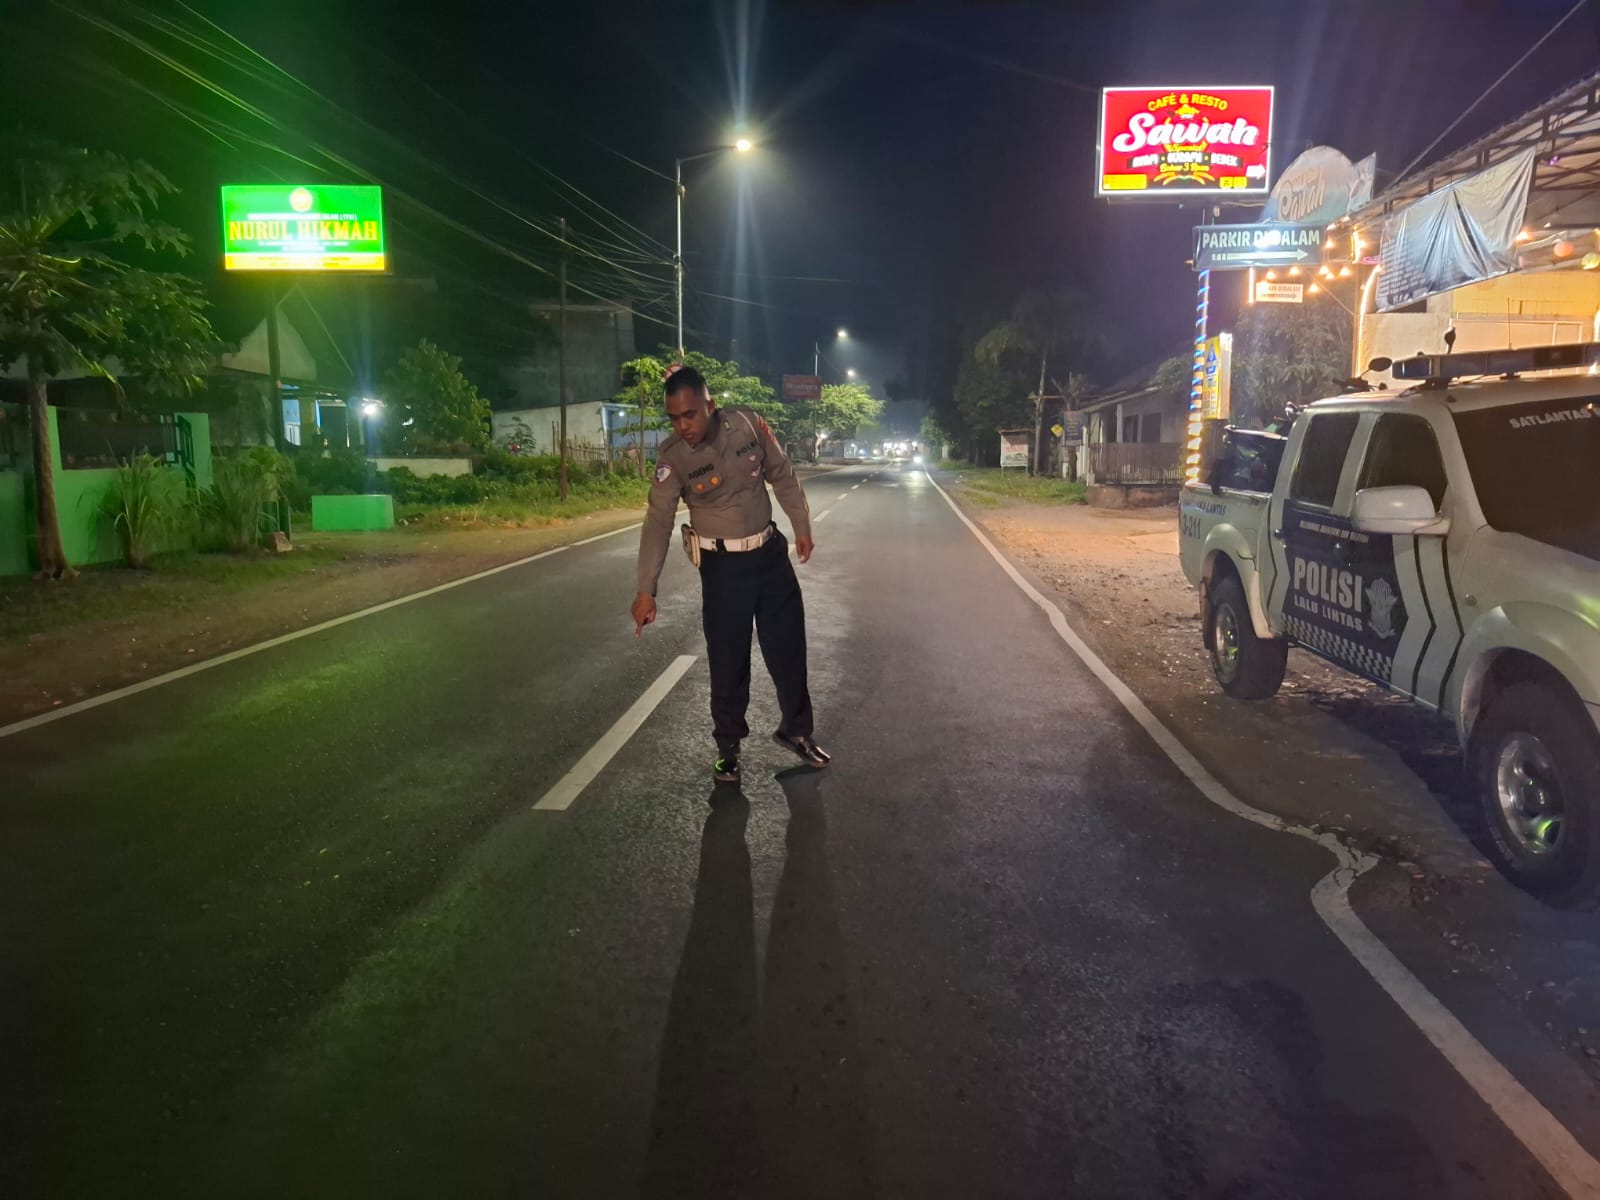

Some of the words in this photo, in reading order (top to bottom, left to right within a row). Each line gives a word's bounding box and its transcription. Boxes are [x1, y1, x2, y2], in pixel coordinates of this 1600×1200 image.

[1147, 92, 1176, 111] CAFÉ
[1180, 93, 1188, 104] &
[1191, 93, 1228, 111] RESTO
[1112, 112, 1259, 152] Sawah
[229, 221, 291, 240] NURUL
[297, 221, 378, 240] HIKMAH
[1202, 231, 1250, 248] PARKIR
[1509, 408, 1592, 428] SATLANTAS
[1294, 557, 1363, 613] POLISI
[1294, 595, 1319, 614] LALU
[1322, 605, 1363, 632] LINTAS
